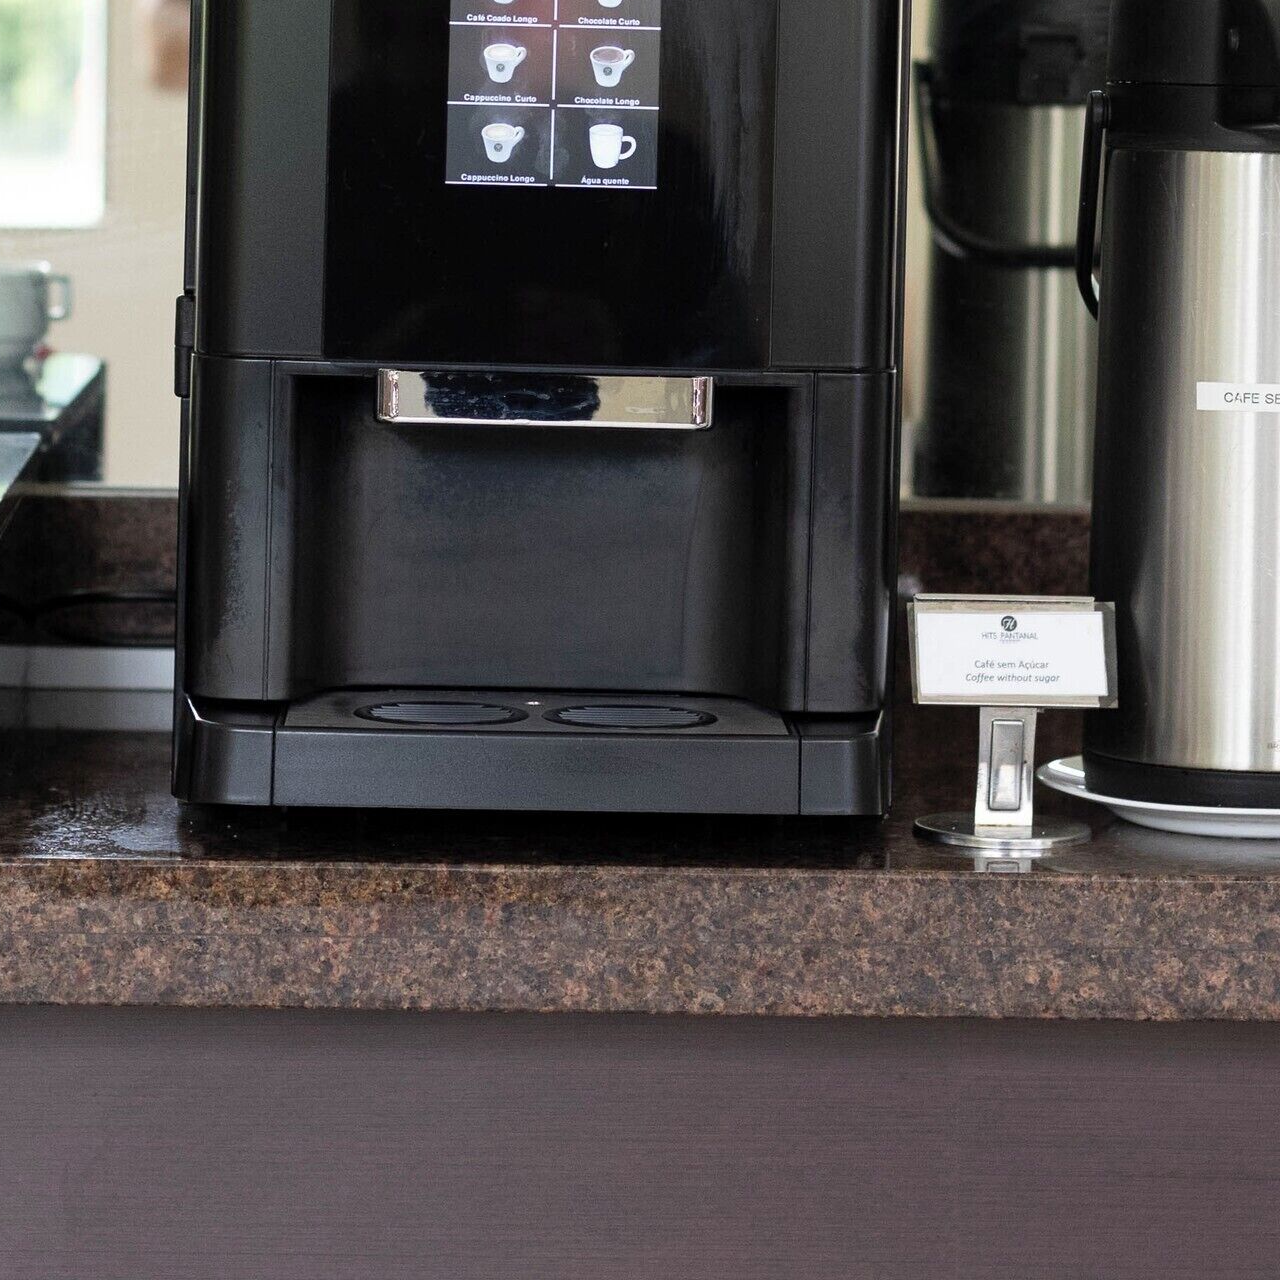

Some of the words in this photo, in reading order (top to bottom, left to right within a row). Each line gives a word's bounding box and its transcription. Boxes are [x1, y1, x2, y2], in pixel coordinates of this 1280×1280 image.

[467, 14, 485, 22] Café
[487, 14, 511, 23] Coado
[513, 15, 538, 24] Longo
[578, 17, 617, 25] Chocolate
[618, 18, 640, 26] Curto
[464, 93, 511, 103] Cappuccino
[515, 94, 537, 103] Curto
[574, 96, 614, 105] Chocolate
[615, 98, 640, 106] Longo
[461, 173, 508, 183] Cappuccino
[510, 174, 535, 183] Longo
[581, 176, 602, 186] Água
[603, 177, 630, 186] quente
[1223, 392, 1260, 404] CAFE
[1000, 632, 1039, 640] PANTANAL
[974, 660, 995, 669] Café
[1019, 660, 1049, 671] Açúcar
[965, 673, 994, 683] Coffee
[997, 673, 1032, 682] without
[1034, 674, 1061, 684] sugar
